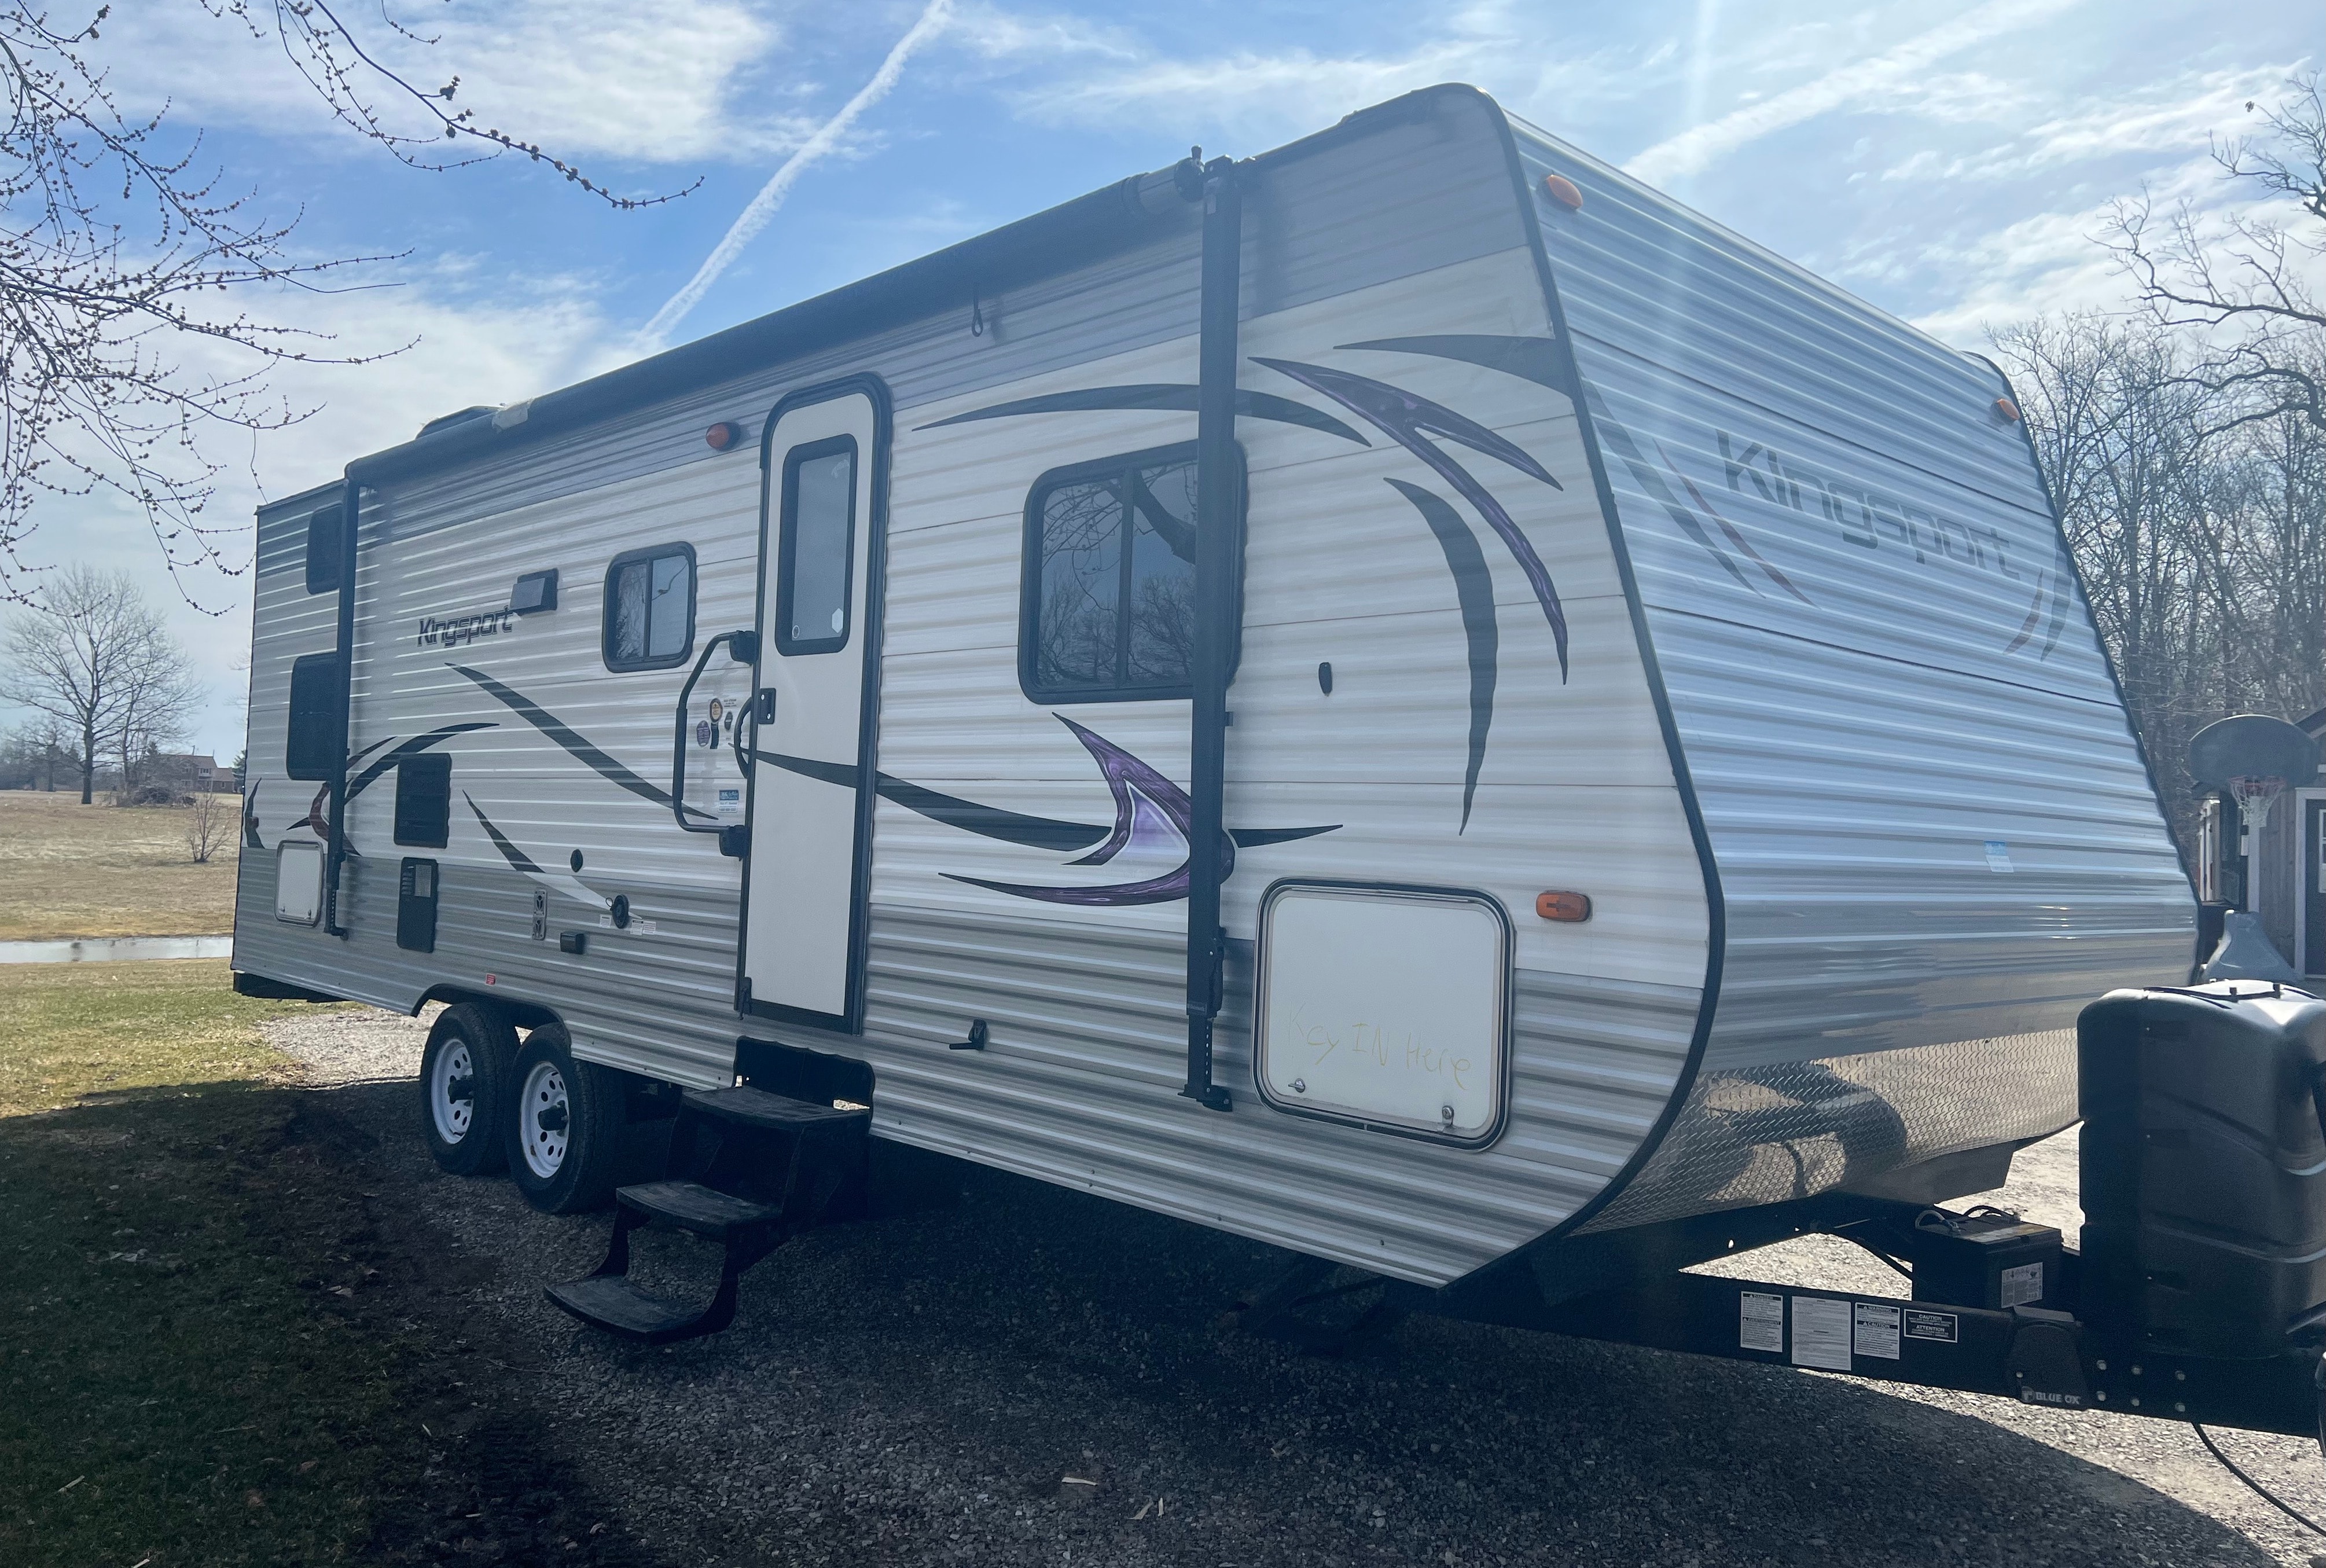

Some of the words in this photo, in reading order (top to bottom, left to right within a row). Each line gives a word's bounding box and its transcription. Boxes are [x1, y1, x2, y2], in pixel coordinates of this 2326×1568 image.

[1716, 429, 2020, 580] Kingsport
[417, 605, 513, 647] Kingsport
[1287, 1002, 1340, 1065] Key
[1352, 1022, 1390, 1066] IN
[1406, 1030, 1471, 1090] Here
[1916, 1324, 1945, 1332] ATTENTION
[2035, 1391, 2062, 1403] BLUE
[2064, 1394, 2080, 1405] OX
